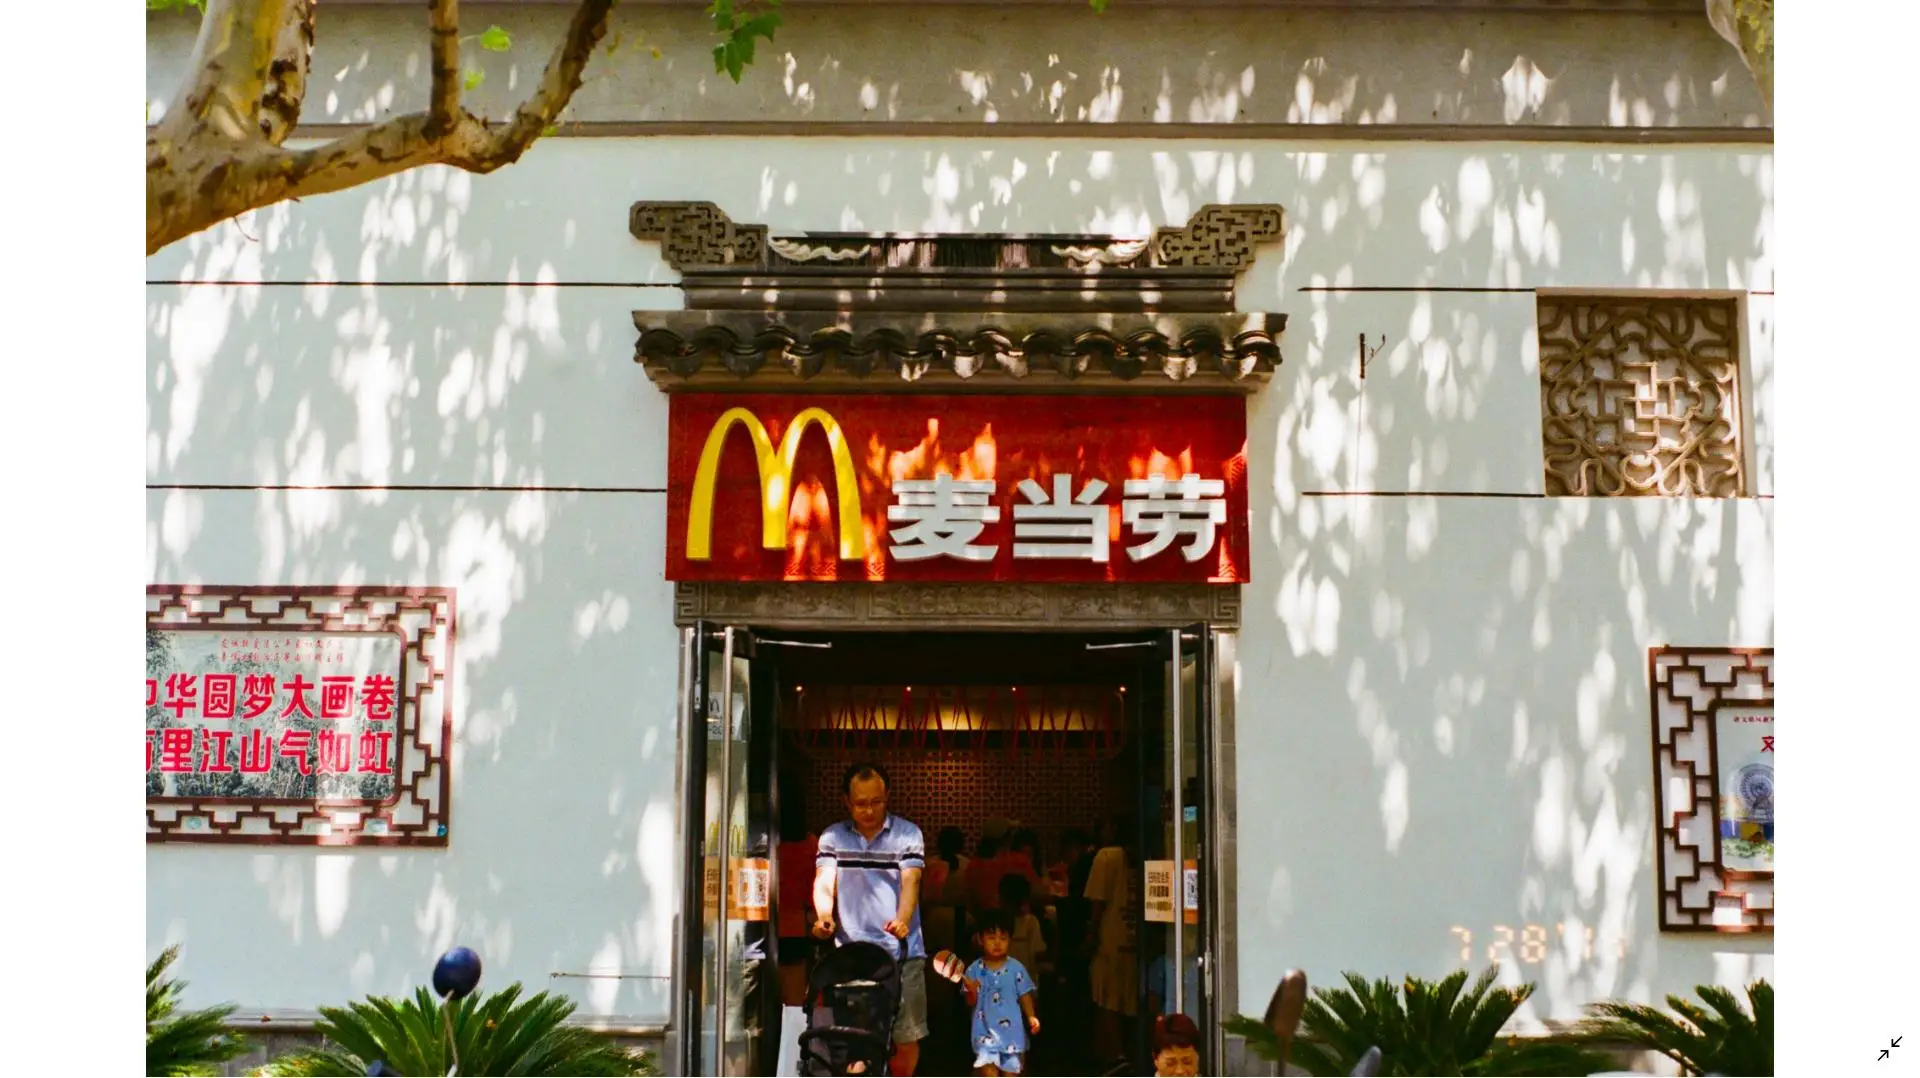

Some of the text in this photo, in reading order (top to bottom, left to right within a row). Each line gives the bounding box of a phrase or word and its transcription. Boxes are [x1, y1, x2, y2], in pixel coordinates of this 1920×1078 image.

[887, 473, 1227, 563] 麦当劳
[146, 728, 393, 776] 里江山气如虹
